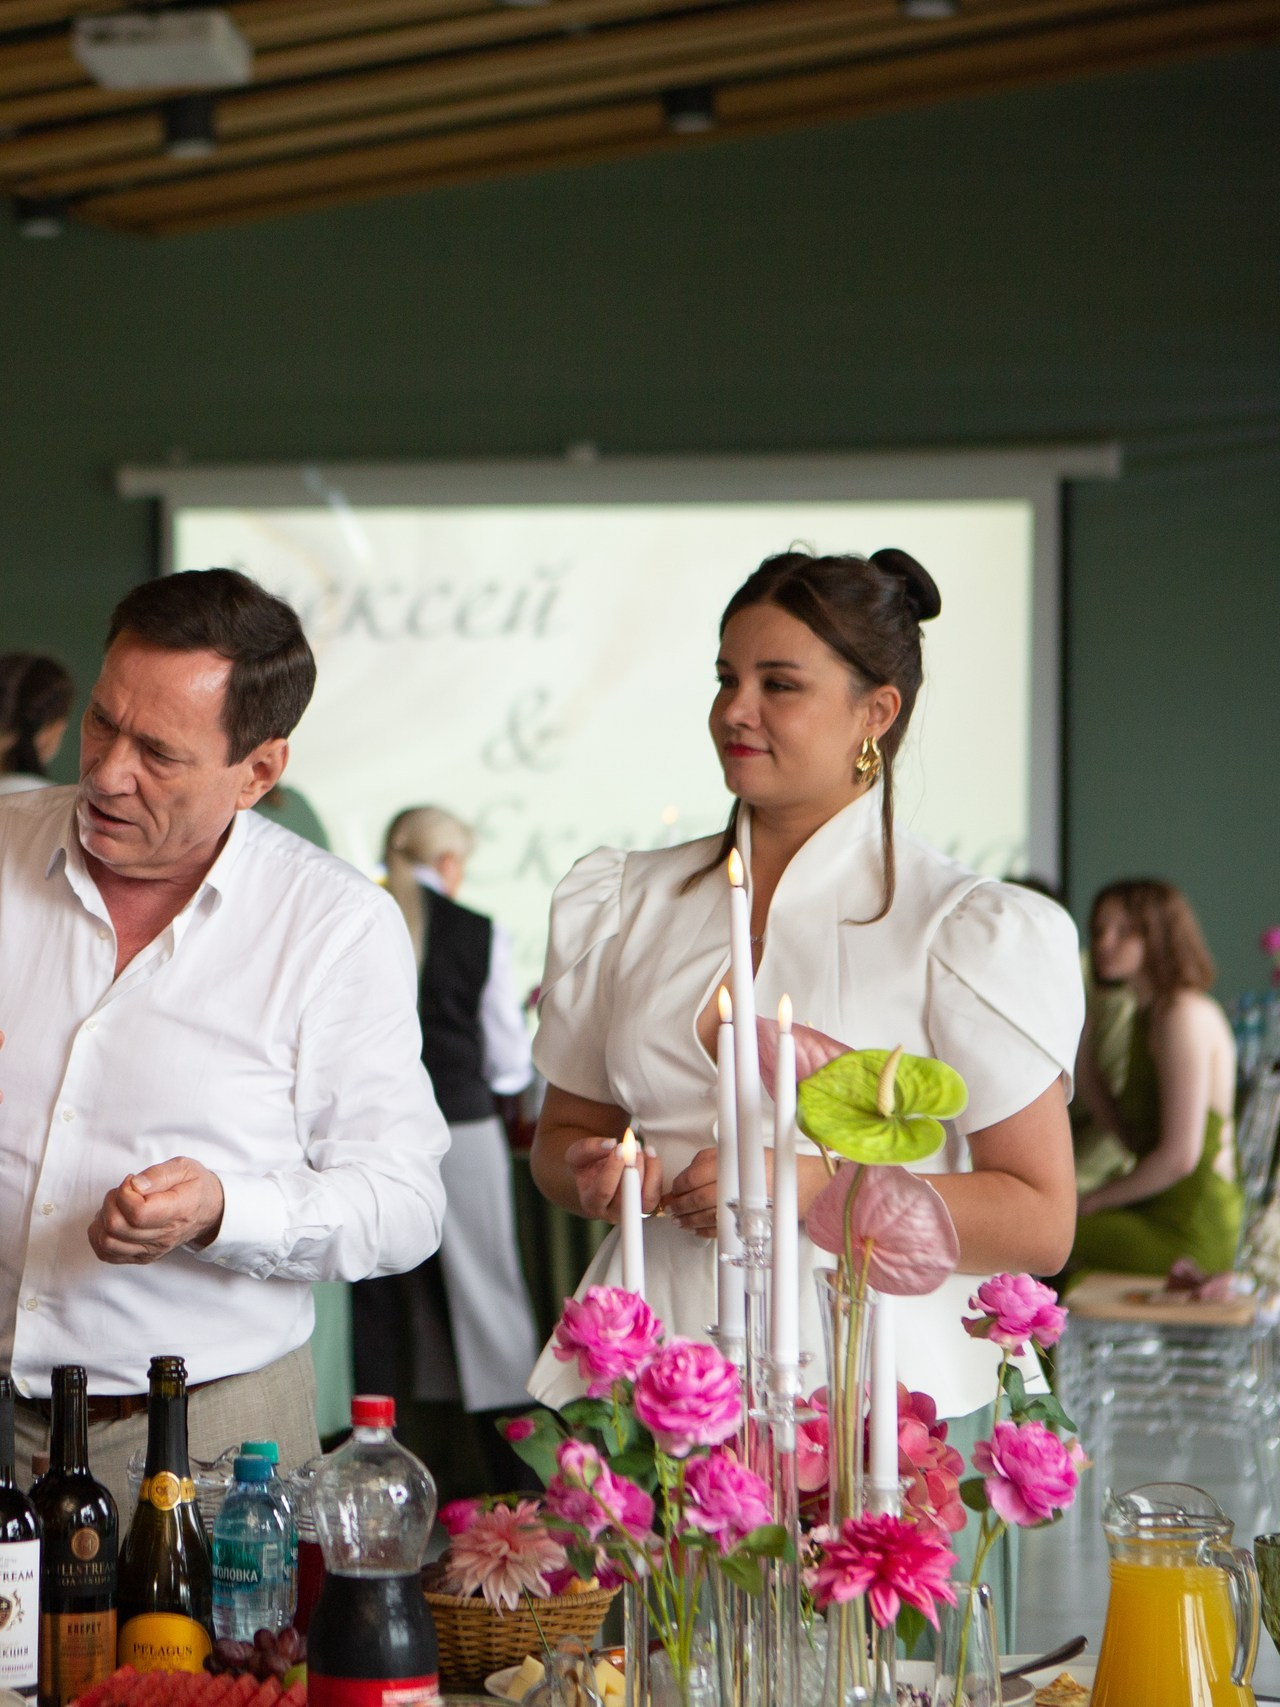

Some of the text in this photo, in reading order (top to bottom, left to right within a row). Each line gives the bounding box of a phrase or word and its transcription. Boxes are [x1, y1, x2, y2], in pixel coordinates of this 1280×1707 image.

[276, 558, 577, 643] ексей
[480, 685, 571, 776] &
[133, 1642, 193, 1657] PELAGUS
